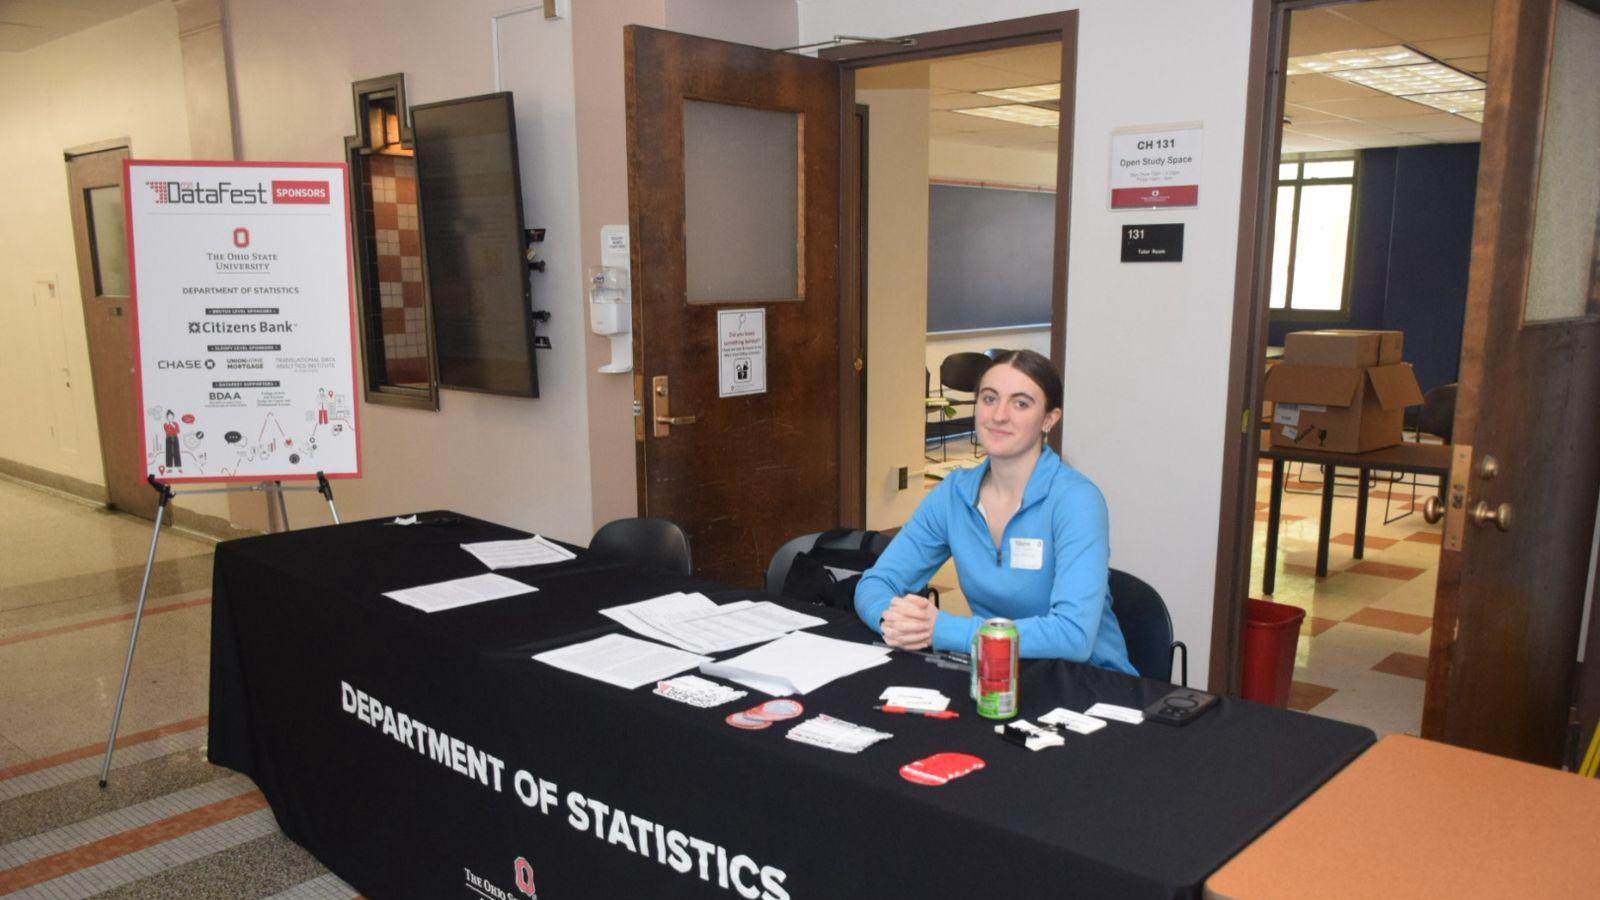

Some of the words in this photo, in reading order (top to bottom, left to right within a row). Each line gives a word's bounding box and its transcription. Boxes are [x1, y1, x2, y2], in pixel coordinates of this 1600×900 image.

[1137, 141, 1153, 150] CH
[1156, 139, 1175, 149] 131
[1120, 159, 1140, 168] Open
[1142, 157, 1165, 166] Study
[1167, 155, 1192, 165] Space
[276, 188, 326, 199] SPONSORS
[1128, 229, 1144, 240] 131
[216, 262, 270, 270] UNIVERSITY
[182, 287, 239, 295] DEPARTMENT
[240, 287, 252, 295] OF
[254, 286, 300, 295] STATISTICS
[203, 321, 257, 333] Citizens
[260, 320, 293, 333] Bank
[157, 360, 202, 370] CHASE
[341, 680, 504, 792] DEPARTMENT
[514, 769, 559, 815] OF
[567, 791, 791, 900] STATISTICS
[464, 867, 482, 888] THE
